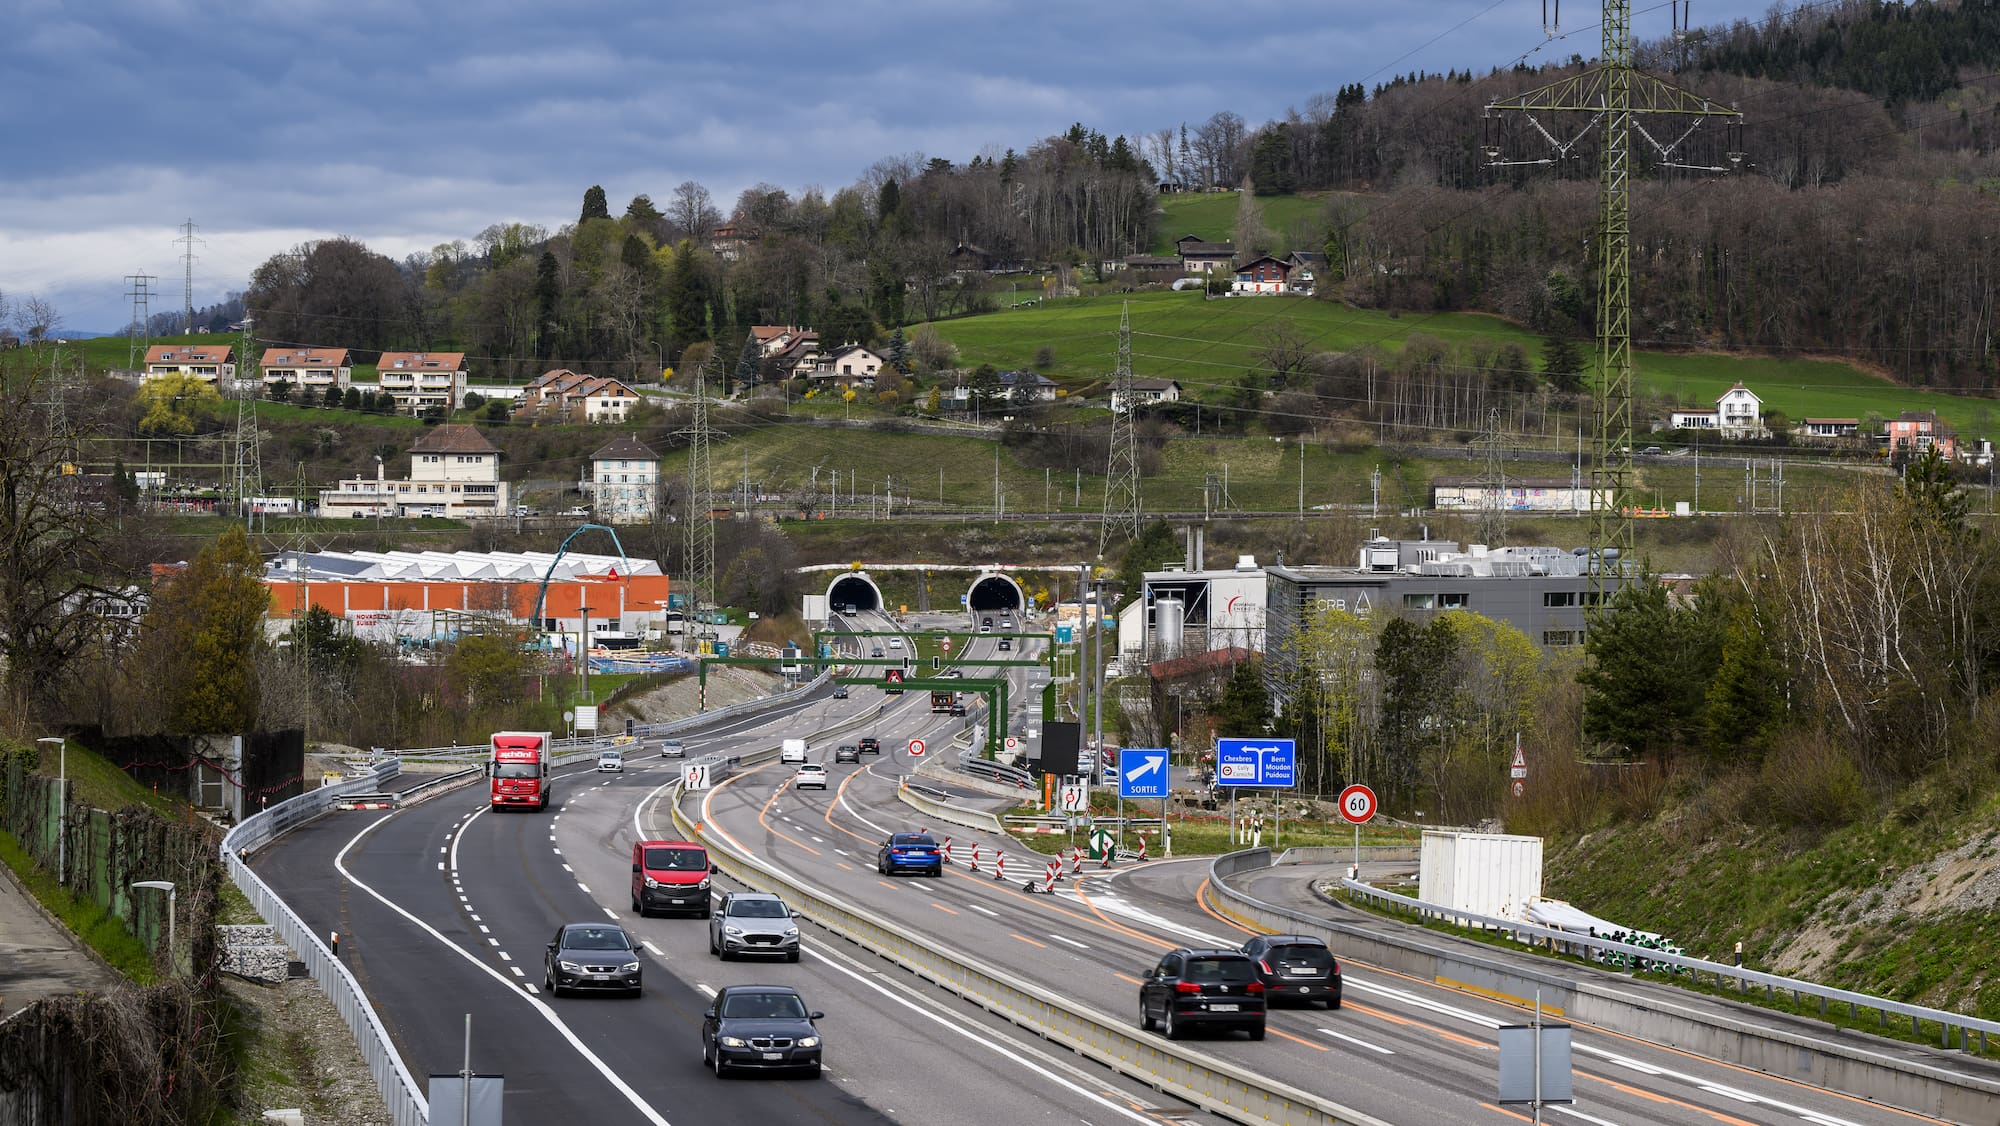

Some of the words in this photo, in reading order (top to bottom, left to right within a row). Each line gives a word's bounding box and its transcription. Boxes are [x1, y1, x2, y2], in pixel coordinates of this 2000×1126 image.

[1317, 599, 1346, 611] CRB
[1131, 785, 1158, 794] SORTIE
[1350, 798, 1366, 811] 60
